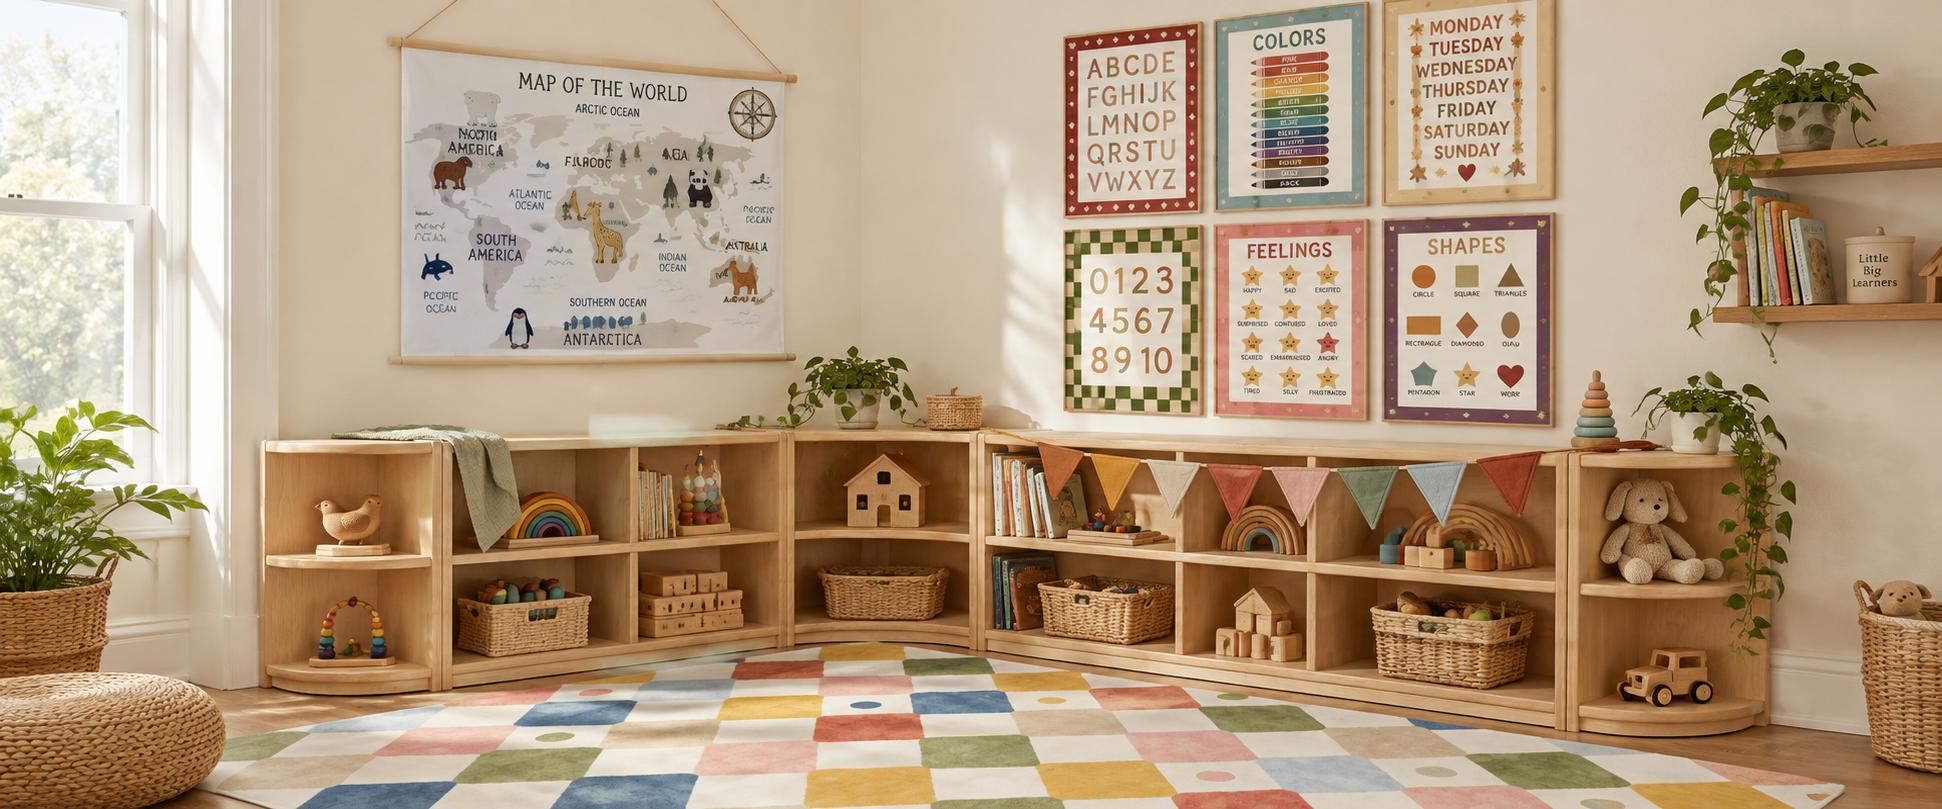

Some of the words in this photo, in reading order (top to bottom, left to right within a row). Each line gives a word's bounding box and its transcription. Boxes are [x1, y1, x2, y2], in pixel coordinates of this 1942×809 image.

[1429, 13, 1504, 36] MONDAY
[1253, 27, 1326, 51] COLORS
[1428, 36, 1504, 57] TUESDAY
[1415, 56, 1517, 78] WEDNESDAY
[518, 71, 557, 92] MAP
[562, 76, 585, 94] OF
[590, 78, 624, 98] THE
[629, 82, 688, 102] WORLD
[1421, 77, 1510, 98] THURSDAY
[575, 103, 608, 115] ARCTIC
[610, 106, 641, 117] OCEAN
[1437, 100, 1497, 118] FRIDAY
[1423, 120, 1510, 140] SATURDAY
[1434, 142, 1501, 160] SUNDAY
[476, 233, 517, 246] SOUTH
[1427, 236, 1506, 256] SHAPES
[468, 248, 523, 262] AMERICA
[658, 252, 687, 262] INDIAN
[1247, 242, 1332, 259] FEELINGS
[1859, 253, 1889, 264] Little
[659, 263, 687, 273] OCEAN
[1863, 265, 1882, 278] Big
[1852, 279, 1898, 288] Learners
[425, 304, 457, 313] OCEAN
[569, 297, 616, 308] SOUTHERN
[618, 298, 647, 308] OCEAN
